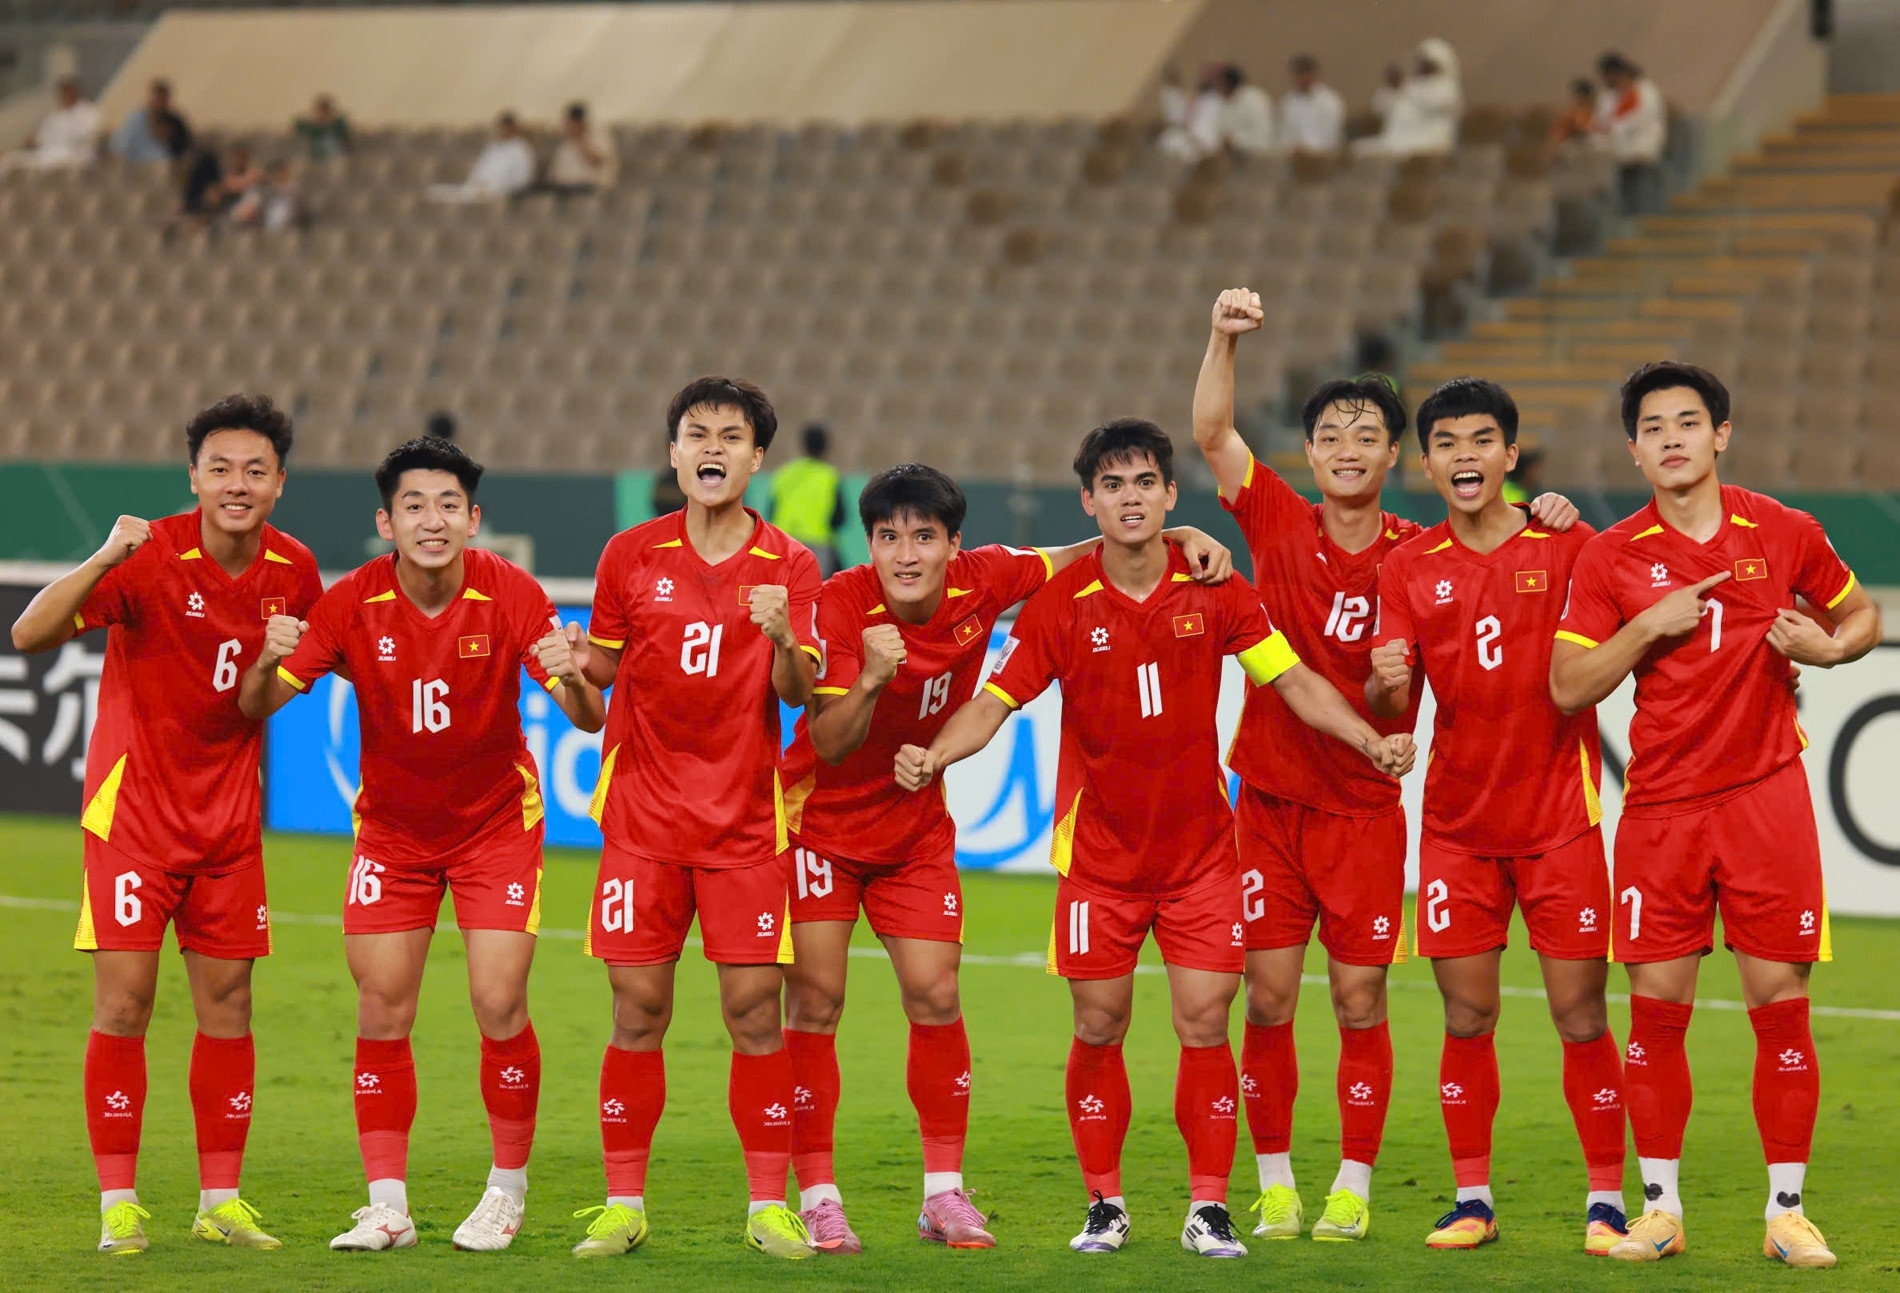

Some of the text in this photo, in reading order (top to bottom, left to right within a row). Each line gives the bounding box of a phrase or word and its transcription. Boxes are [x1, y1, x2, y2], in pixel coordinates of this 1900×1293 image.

[1323, 591, 1370, 642] 12
[1475, 614, 1503, 671] 2
[1701, 597, 1724, 653] 7
[212, 638, 242, 692] 6
[680, 621, 724, 678] 21
[412, 678, 451, 734] 16
[918, 671, 952, 720] 19
[1136, 661, 1163, 719] 11
[114, 870, 142, 927] 6
[348, 855, 386, 906] 16
[795, 847, 833, 900] 19
[1241, 868, 1265, 923] 2
[601, 877, 634, 934] 21
[1069, 900, 1090, 955] 11
[1427, 878, 1451, 933] 2
[1621, 885, 1643, 941] 7
